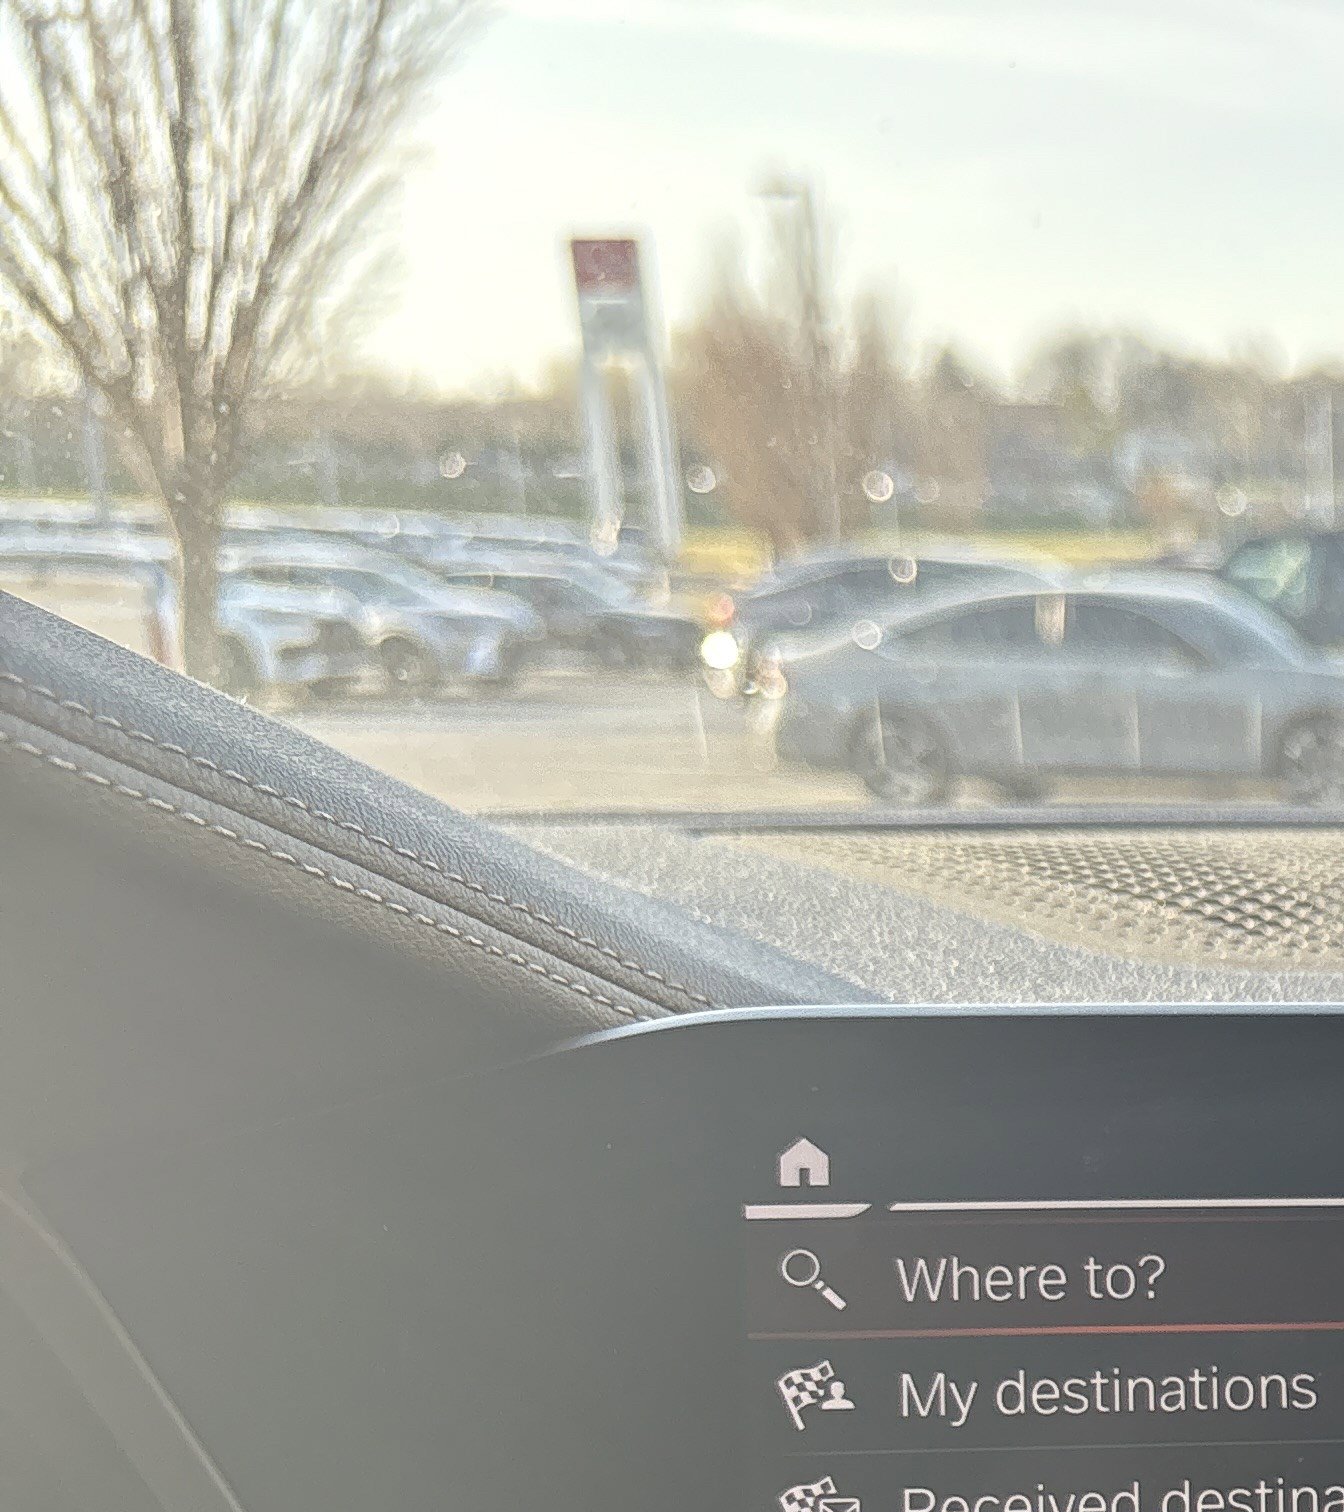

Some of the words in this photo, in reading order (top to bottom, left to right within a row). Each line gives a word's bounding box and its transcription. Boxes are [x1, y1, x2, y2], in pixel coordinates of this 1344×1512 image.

[896, 1254, 1067, 1302] Where
[1083, 1256, 1166, 1300] to?
[899, 1371, 979, 1427] My
[995, 1365, 1319, 1416] destinations
